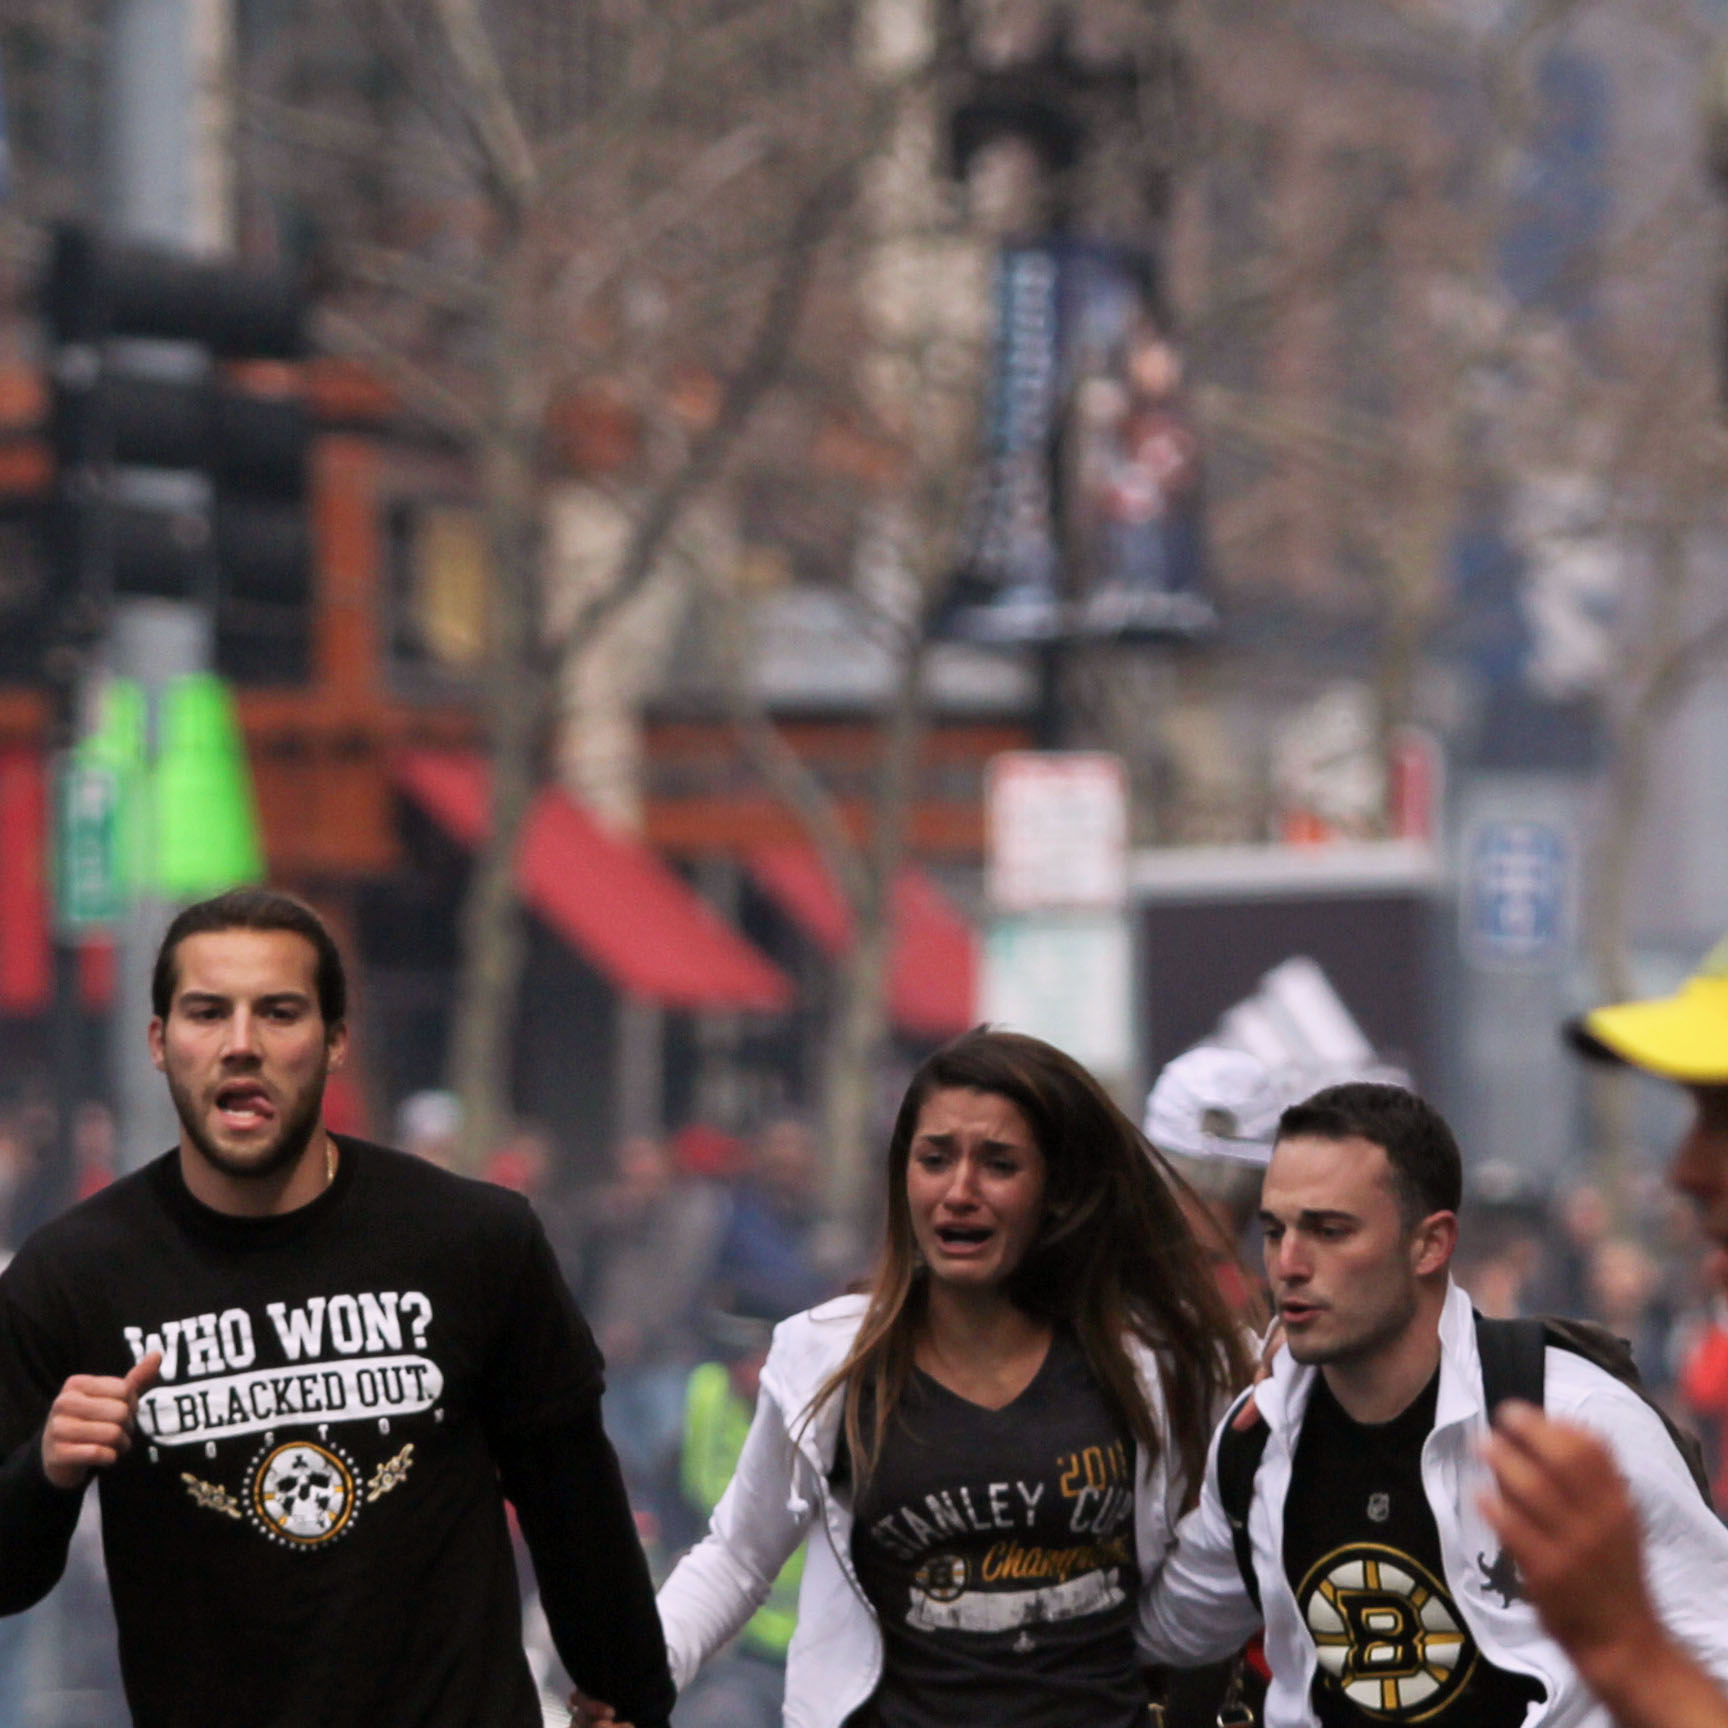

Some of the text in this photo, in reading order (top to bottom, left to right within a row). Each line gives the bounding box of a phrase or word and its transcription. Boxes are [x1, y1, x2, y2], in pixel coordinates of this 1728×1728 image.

[123, 1291, 434, 1380] WHO WON?
[145, 1397, 164, 1436] I
[173, 1370, 347, 1433] BLACKED
[1056, 1438, 1129, 1498] 2011
[981, 1540, 1129, 1584] Champ
